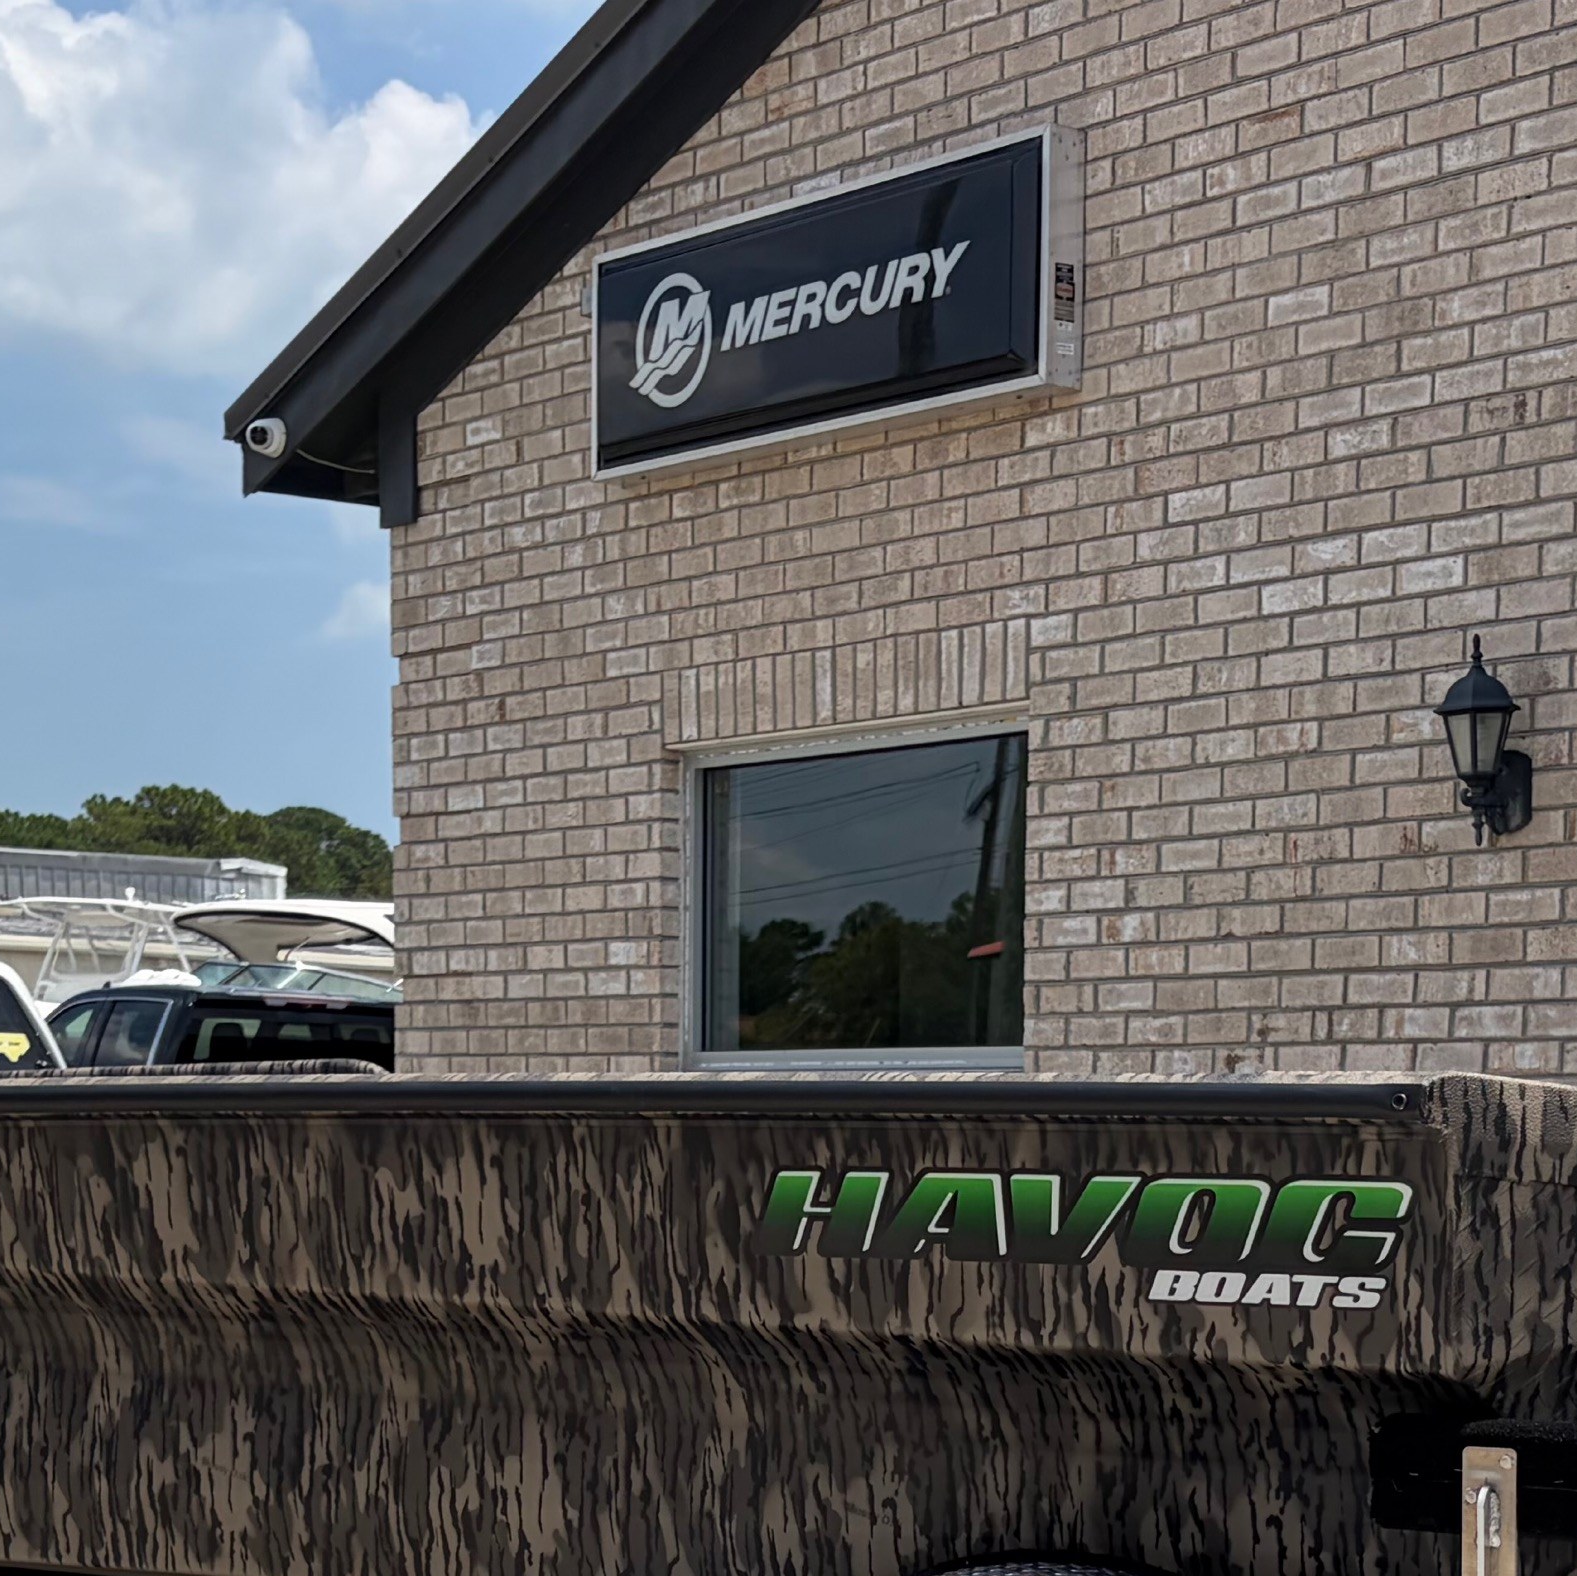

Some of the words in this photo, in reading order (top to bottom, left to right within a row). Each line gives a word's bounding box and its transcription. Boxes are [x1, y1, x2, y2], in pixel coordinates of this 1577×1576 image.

[720, 240, 971, 353] MERCURY
[758, 1169, 1415, 1267] HAVOC
[1147, 1268, 1388, 1310] BOATS
